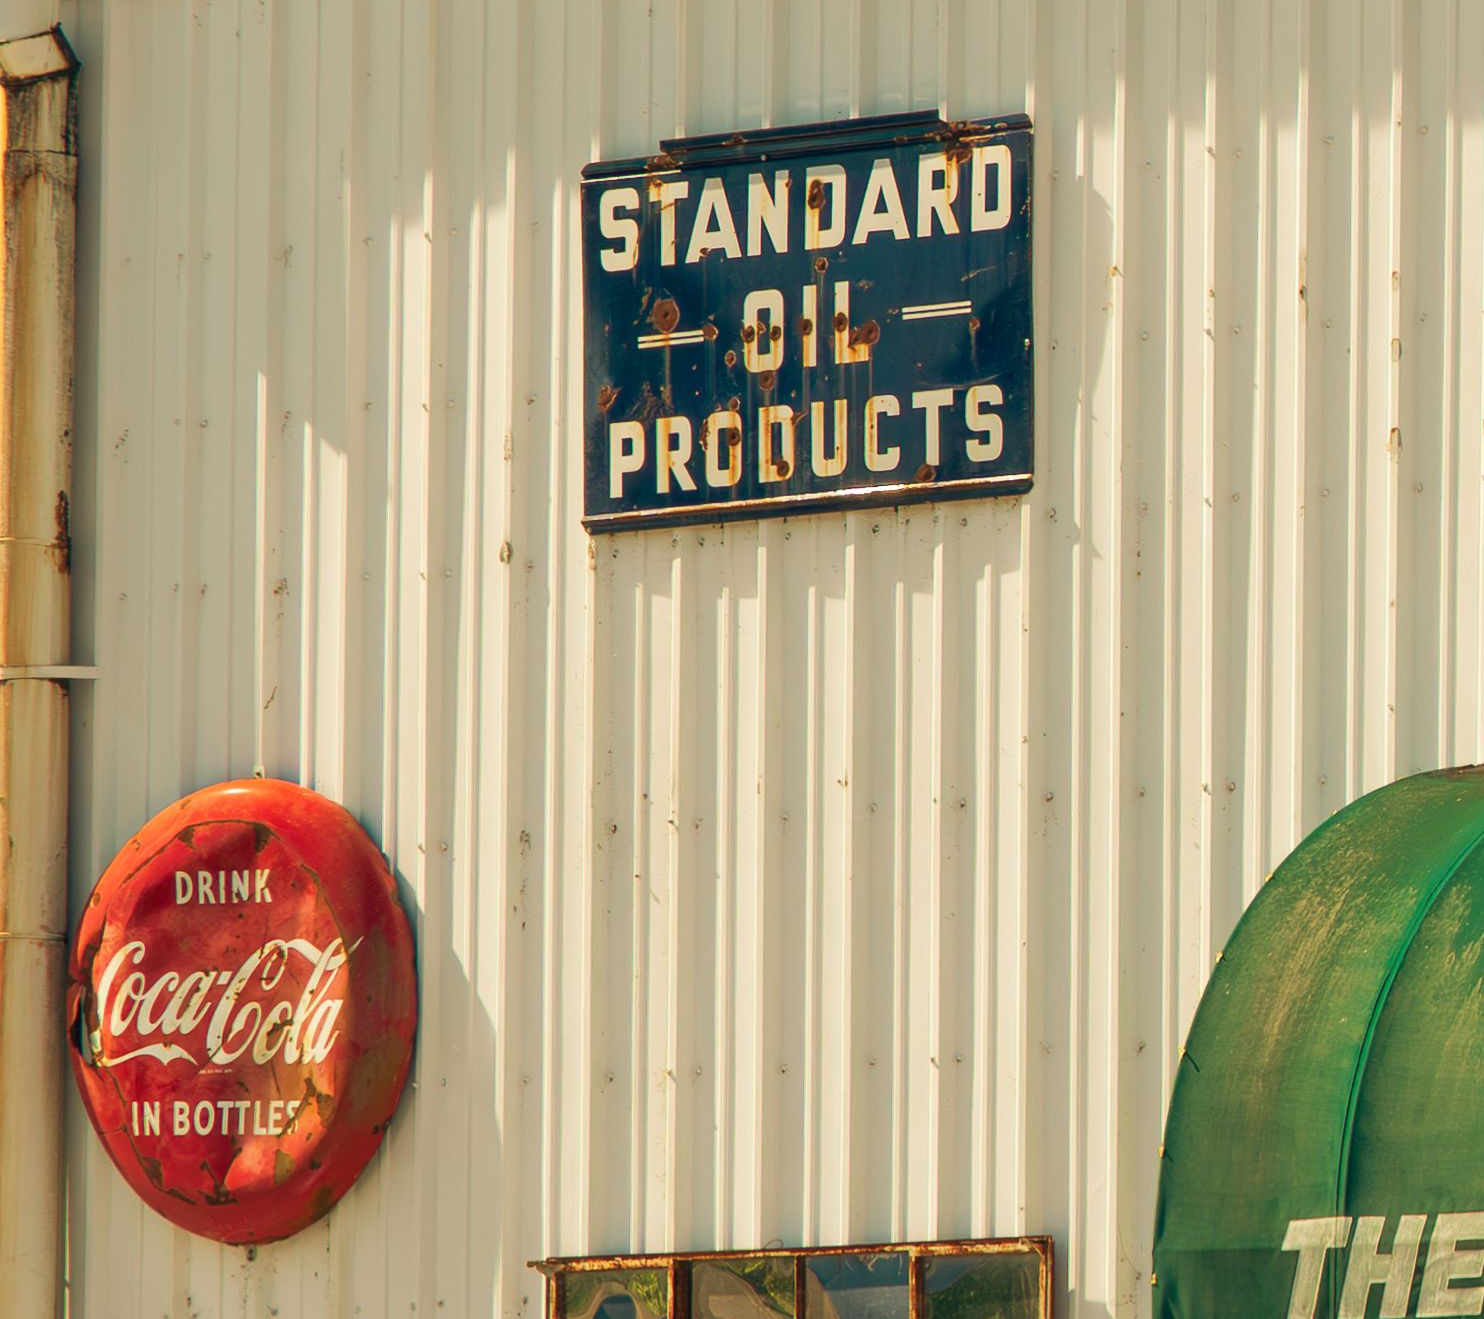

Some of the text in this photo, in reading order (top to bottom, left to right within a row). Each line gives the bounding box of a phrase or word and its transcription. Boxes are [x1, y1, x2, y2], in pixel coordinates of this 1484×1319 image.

[600, 144, 1012, 272] STANDARD
[743, 281, 870, 374] OIL
[609, 384, 1004, 499] PRODUCTS
[175, 869, 272, 905] DRINK
[91, 936, 364, 1066] Coca-Cola
[131, 1100, 301, 1136] IN BOTTLES
